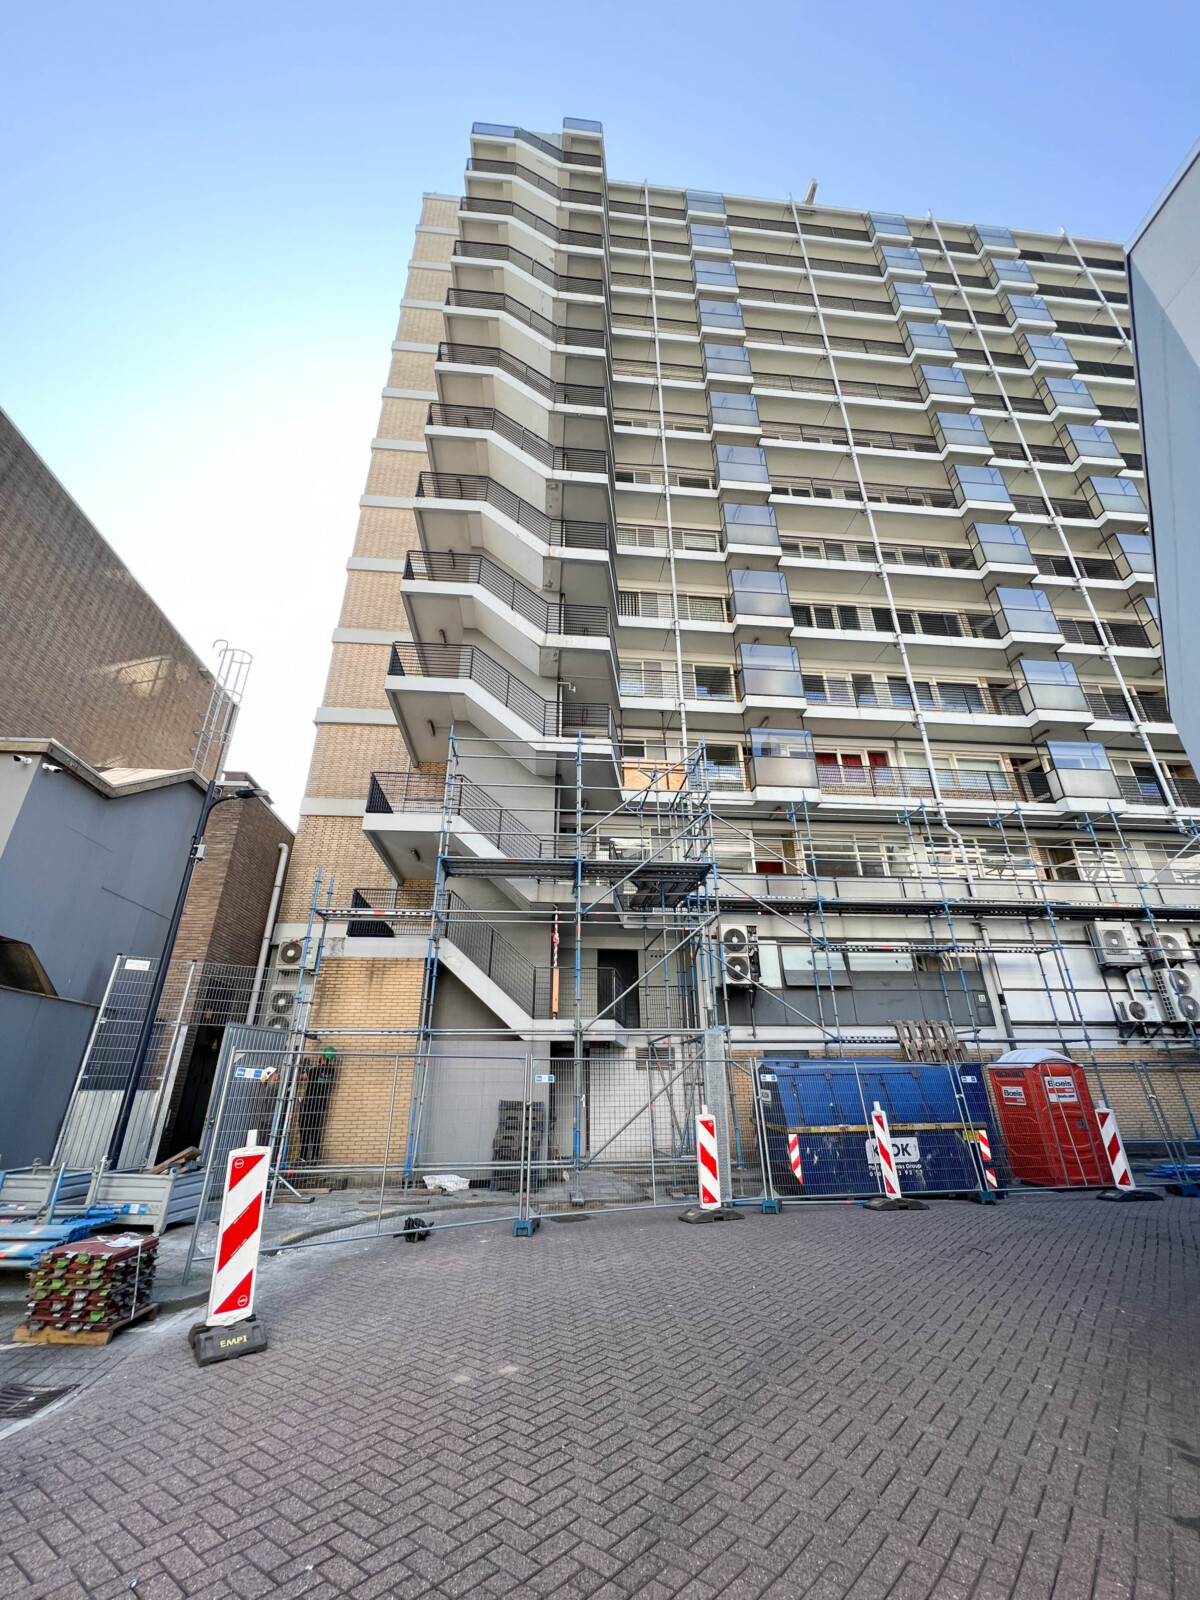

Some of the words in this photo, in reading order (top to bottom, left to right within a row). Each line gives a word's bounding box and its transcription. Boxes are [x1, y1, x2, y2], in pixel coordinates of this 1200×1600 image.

[1003, 1089, 1023, 1097] Boels
[872, 1143, 912, 1157] KOK
[220, 1335, 247, 1348] EMPI
